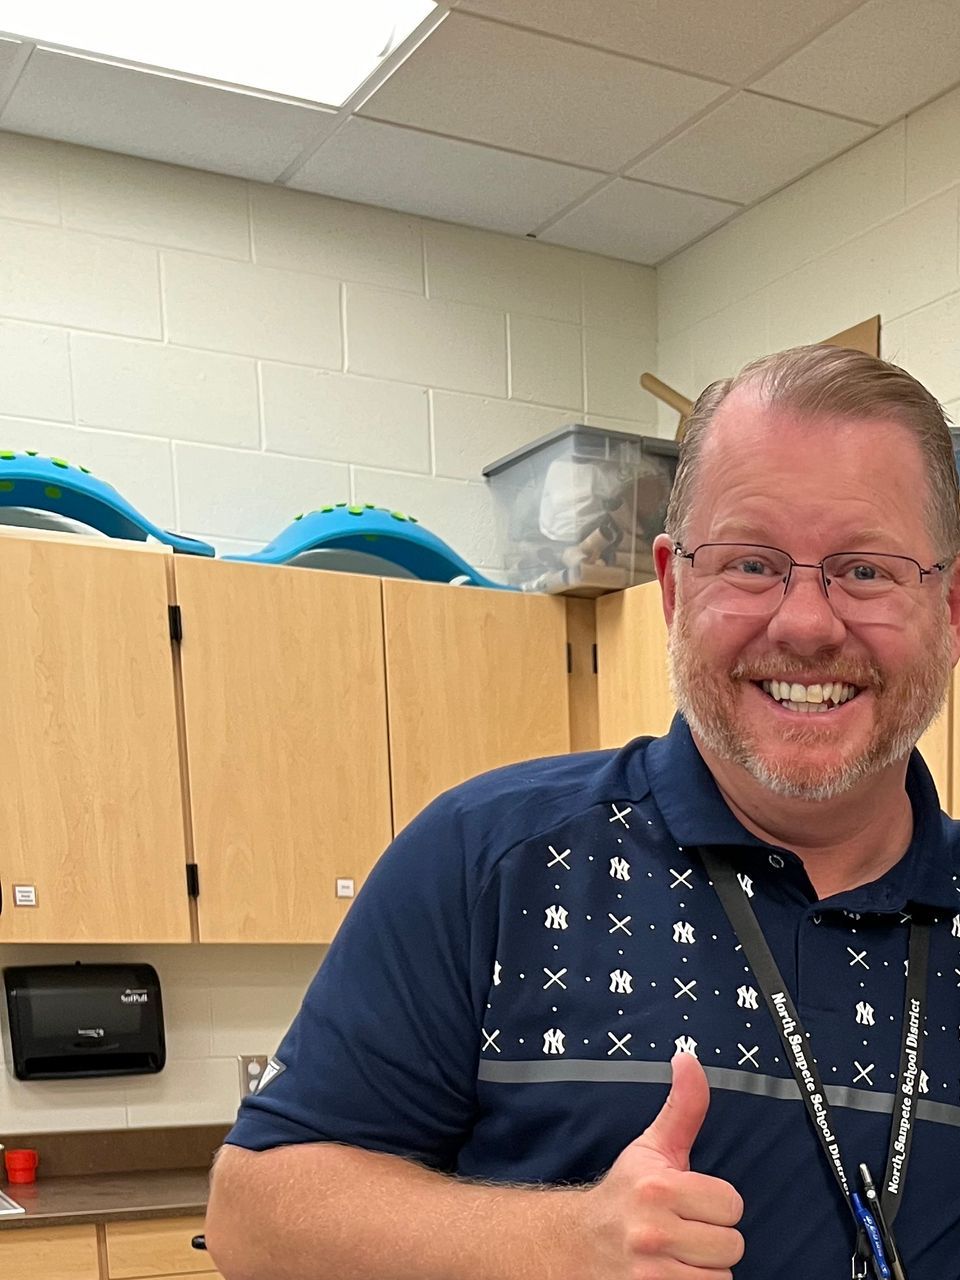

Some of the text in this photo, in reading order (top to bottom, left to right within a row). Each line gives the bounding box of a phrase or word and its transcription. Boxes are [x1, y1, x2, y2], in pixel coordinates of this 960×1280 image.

[771, 992, 796, 1038] North
[788, 1031, 817, 1093] Sanpete
[810, 1092, 836, 1144] School
[887, 998, 922, 1195] North Sanpete School District
